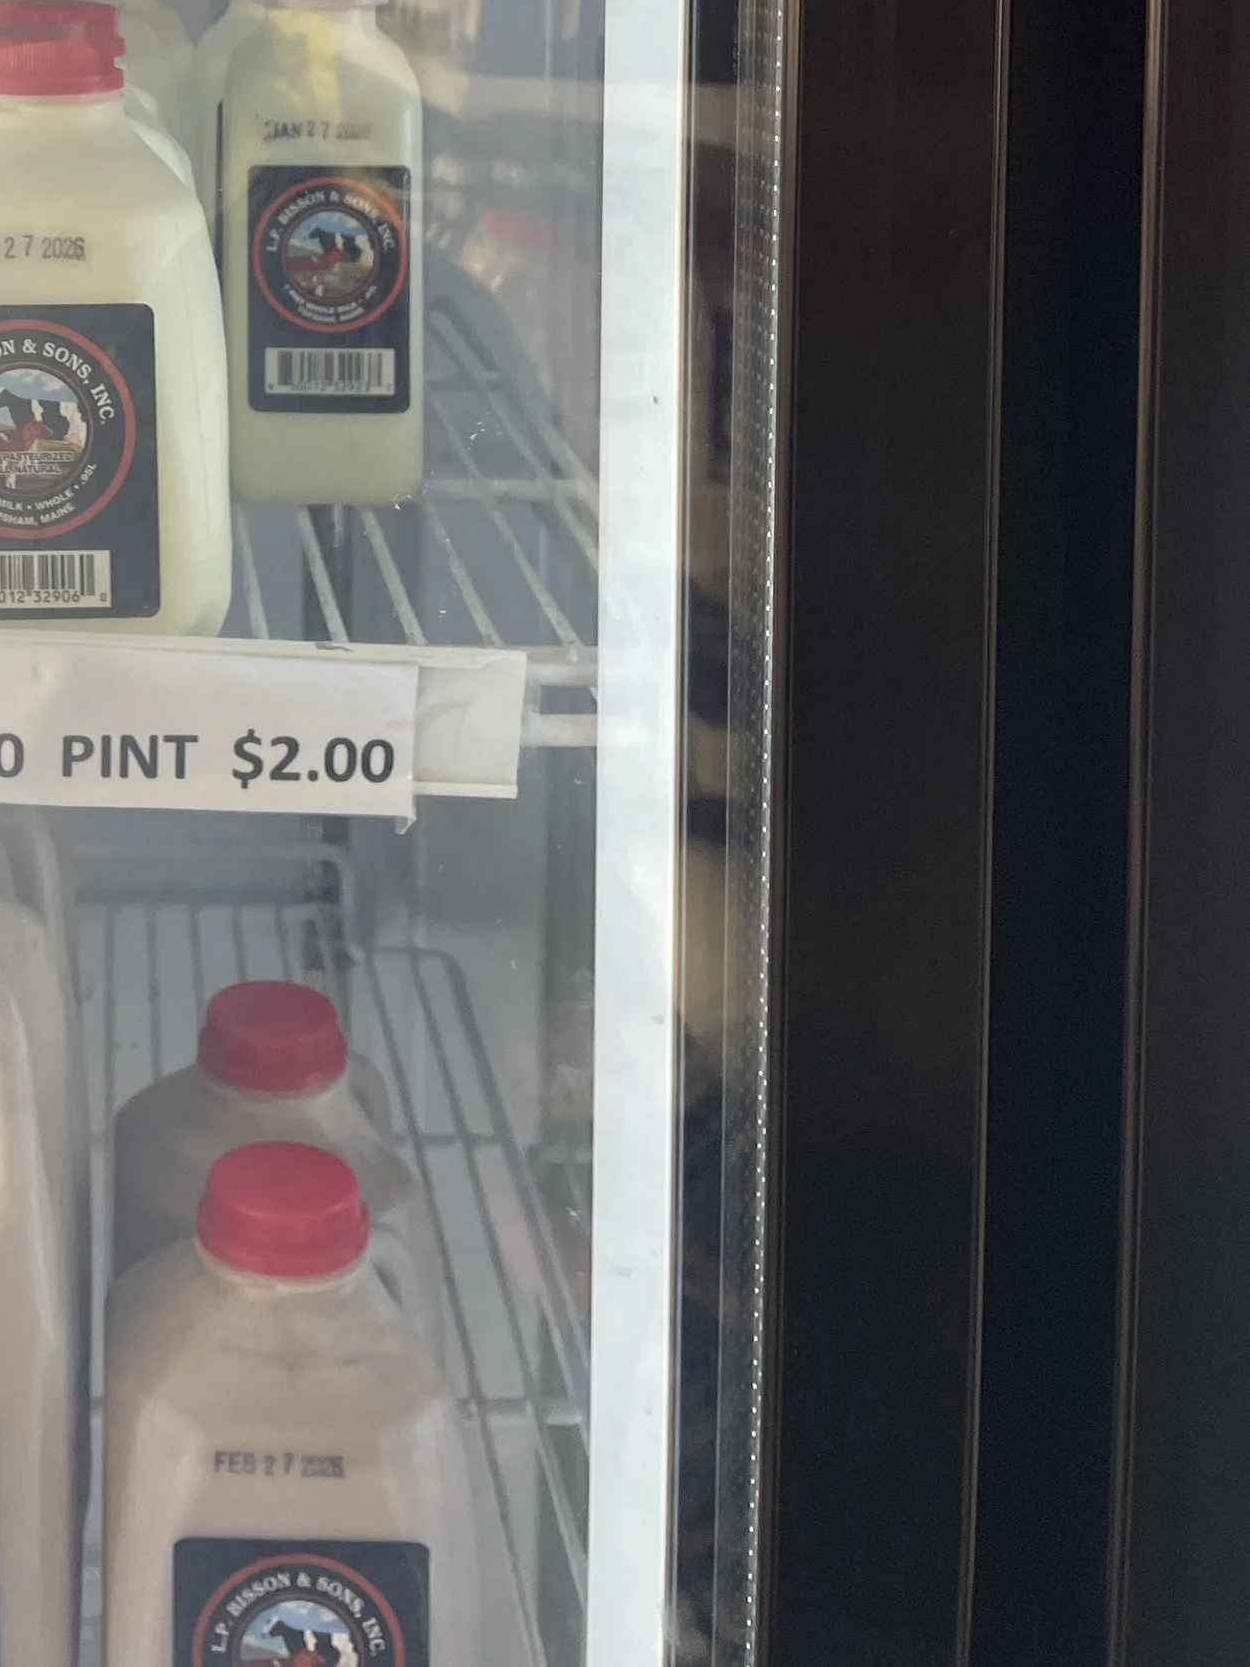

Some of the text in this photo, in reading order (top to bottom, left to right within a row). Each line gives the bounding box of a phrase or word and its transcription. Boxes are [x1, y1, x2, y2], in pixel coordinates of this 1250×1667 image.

[41, 235, 87, 262] 2026
[21, 337, 38, 355] &
[41, 342, 93, 386] SONS,
[89, 383, 116, 425] INC.
[2, 451, 74, 462] PASTEURIZED
[13, 463, 63, 475] NATURAL
[33, 487, 76, 511] WHOLE
[39, 501, 77, 524] MAINE
[32, 589, 81, 604] 32906
[61, 733, 200, 781] PINT
[231, 727, 396, 790] $2.00
[225, 1570, 292, 1618] BISSON
[296, 1570, 312, 1588] &
